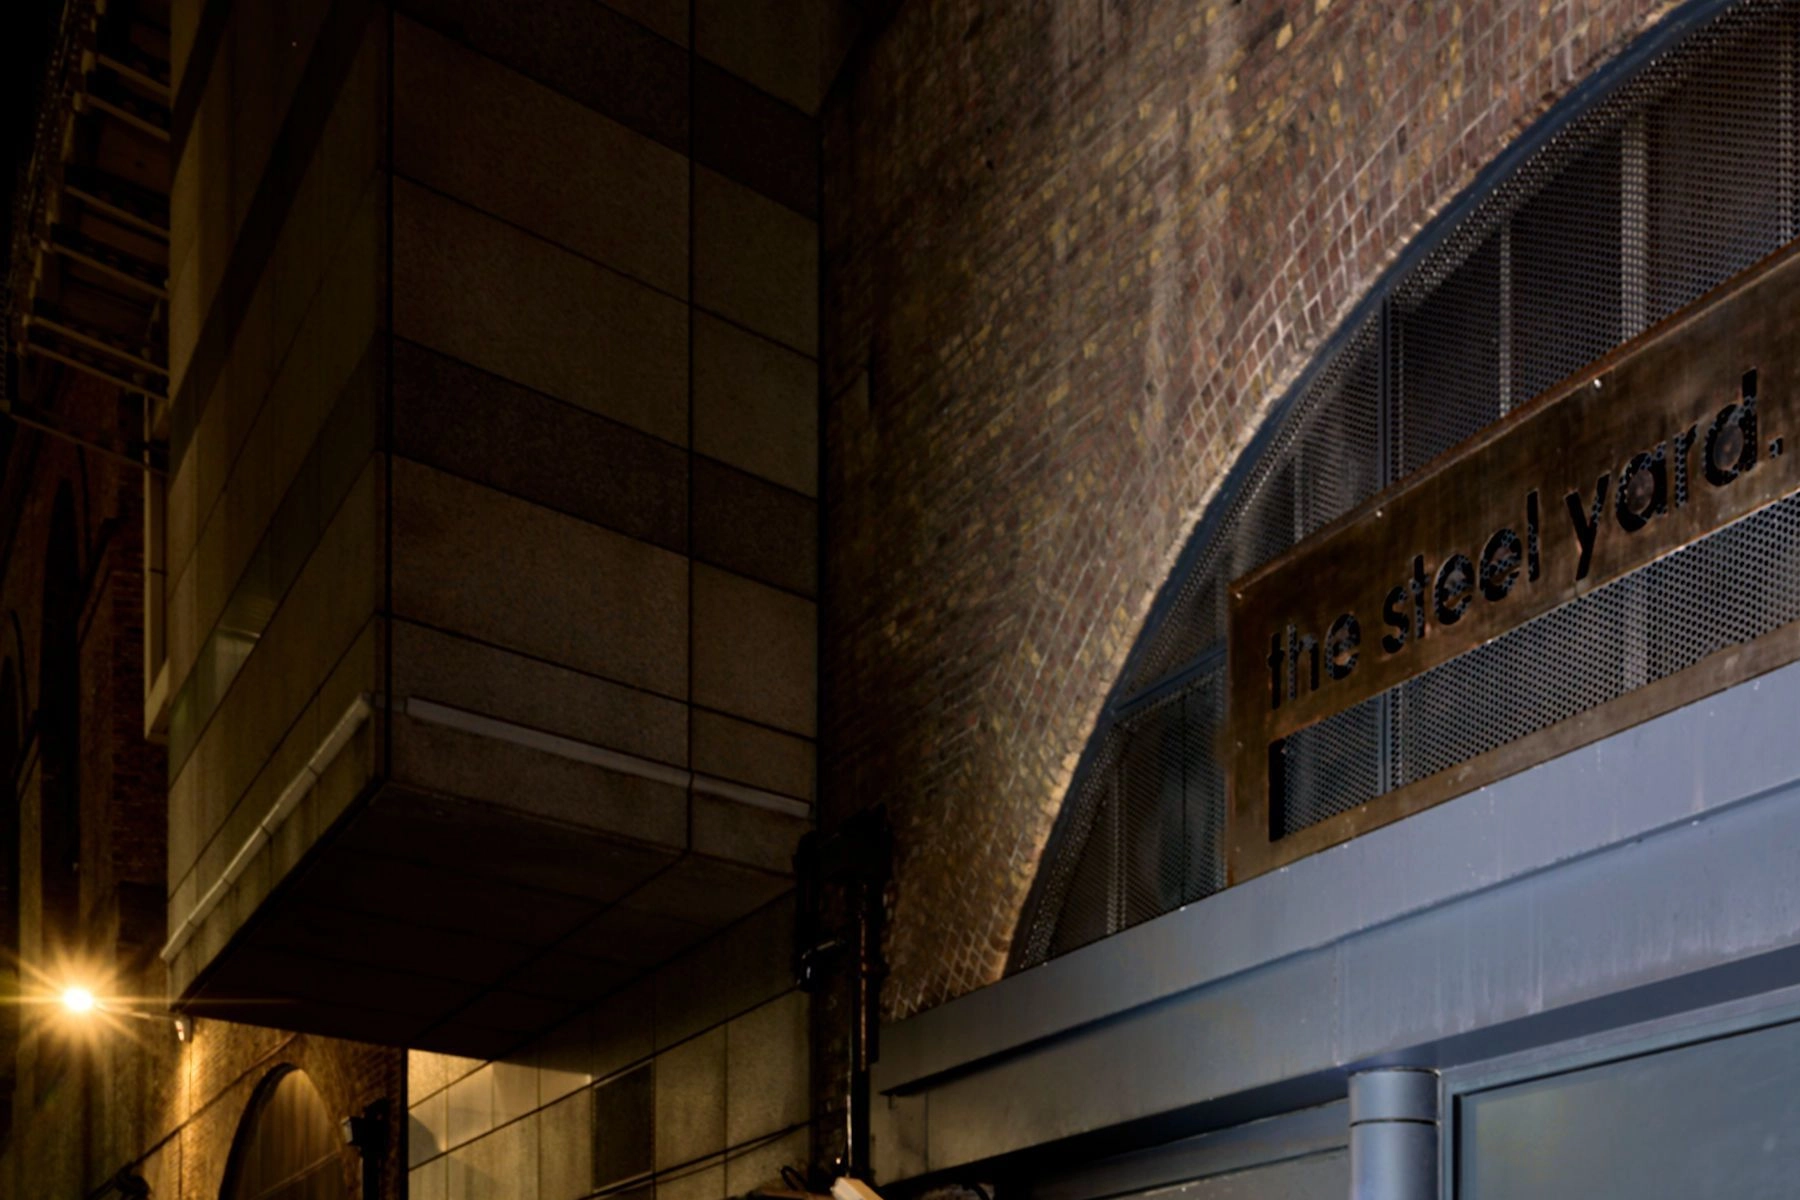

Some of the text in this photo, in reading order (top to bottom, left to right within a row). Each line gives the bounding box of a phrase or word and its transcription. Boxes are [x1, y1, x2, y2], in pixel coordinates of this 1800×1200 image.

[1267, 368, 1784, 709] the steel yard.
